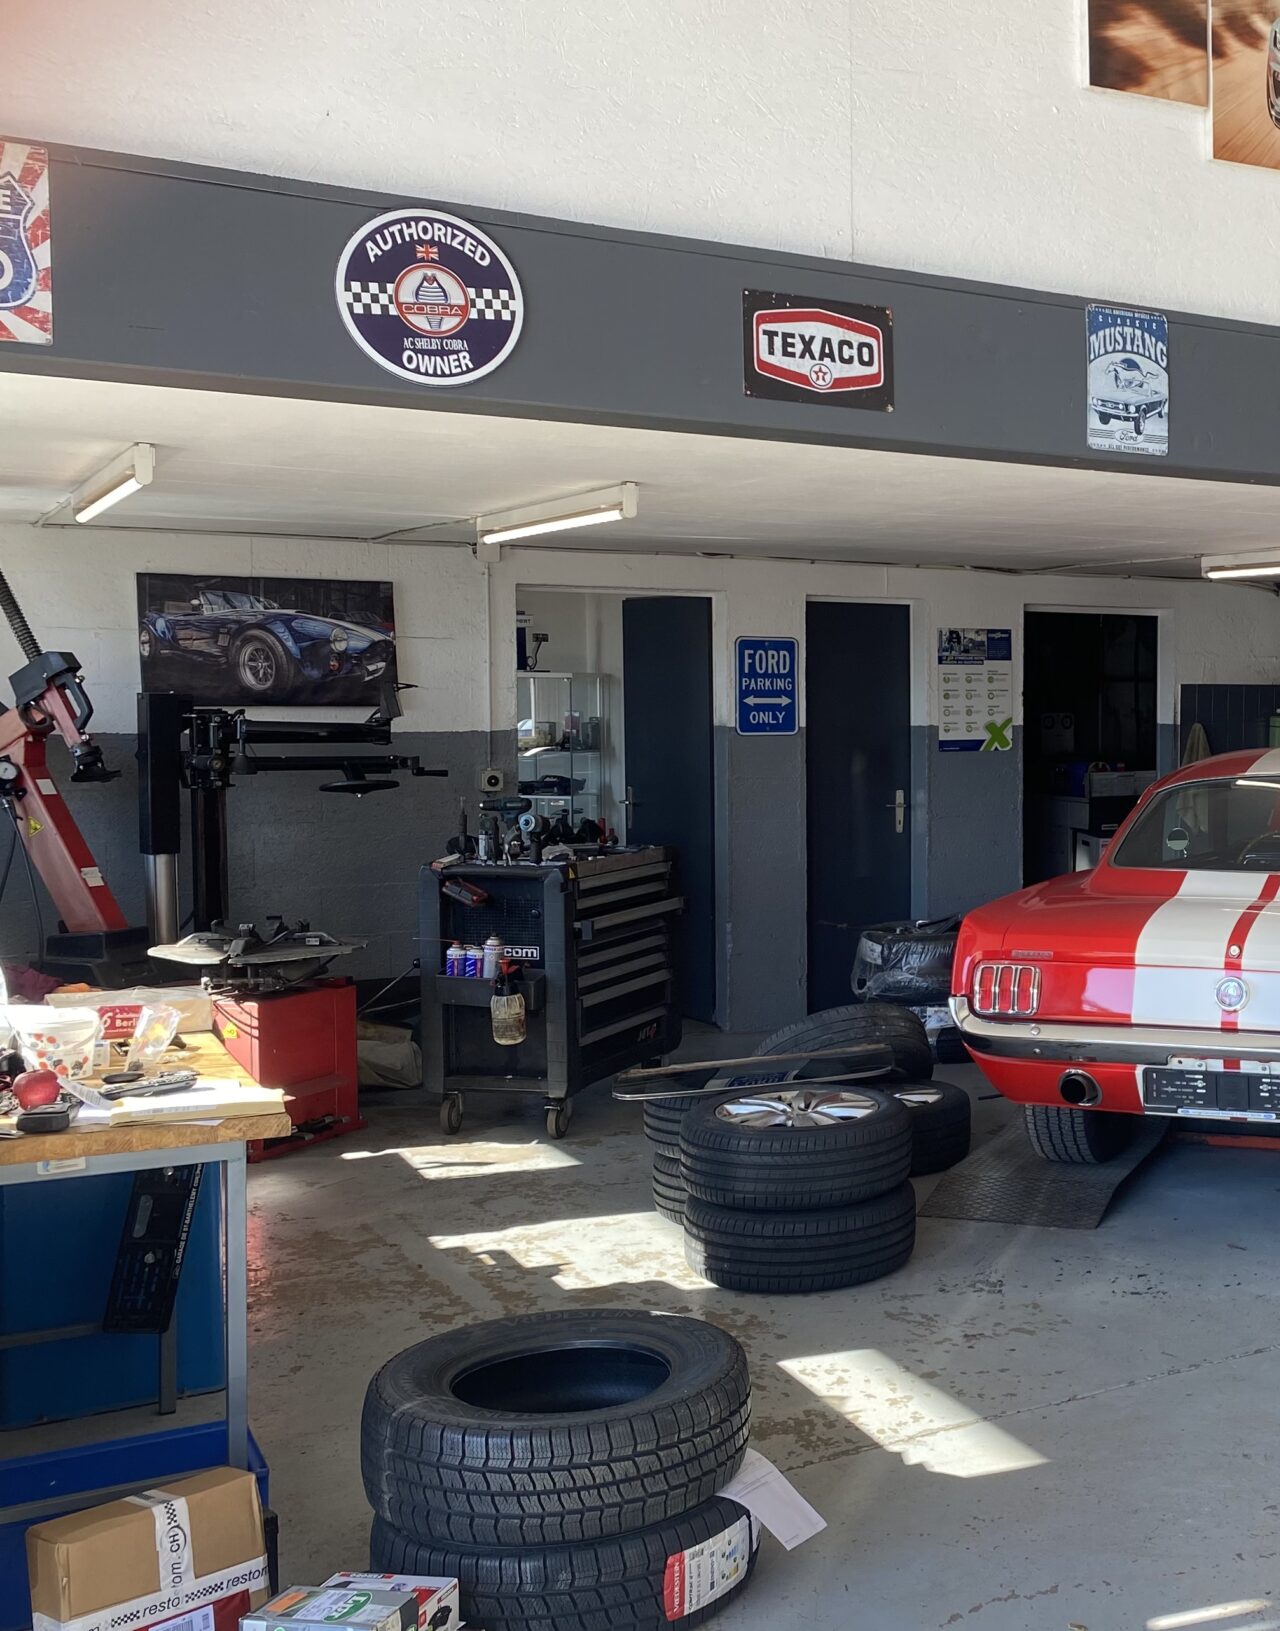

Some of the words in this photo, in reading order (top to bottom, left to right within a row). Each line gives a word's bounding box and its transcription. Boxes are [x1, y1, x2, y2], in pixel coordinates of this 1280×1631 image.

[364, 221, 491, 267] AUTHORIZED
[402, 304, 463, 316] COBRA
[403, 338, 414, 349] AC
[415, 338, 442, 350] SHELBY
[442, 339, 469, 350] COBRA
[762, 329, 875, 367] TEXACO
[1089, 326, 1168, 369] MUSTANG
[402, 350, 474, 376] OWNER
[744, 649, 790, 674] FORD
[742, 678, 793, 691] PARKING
[750, 711, 786, 724] ONLY
